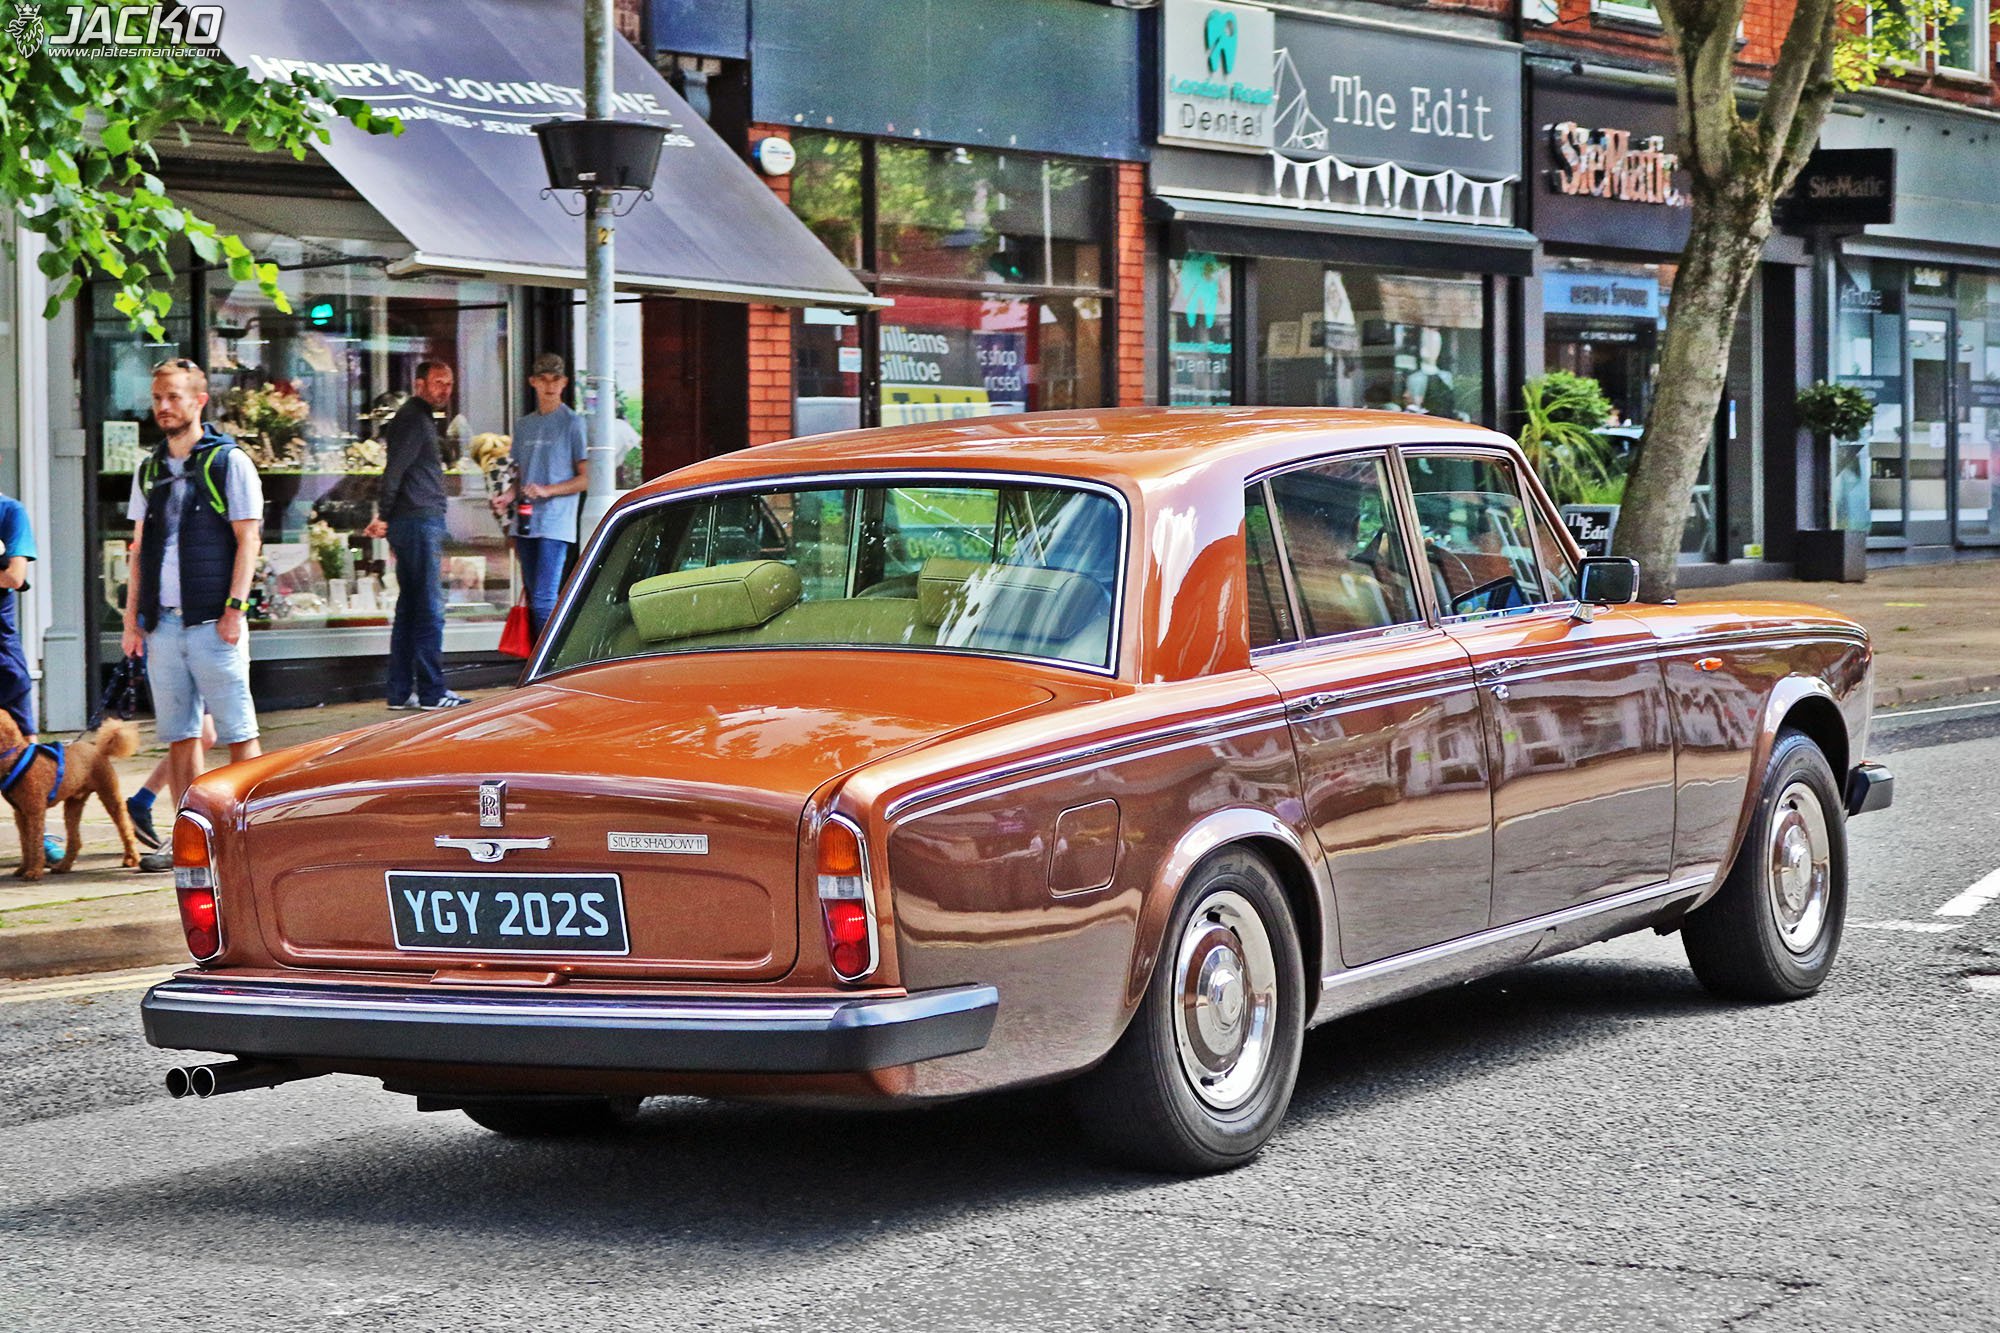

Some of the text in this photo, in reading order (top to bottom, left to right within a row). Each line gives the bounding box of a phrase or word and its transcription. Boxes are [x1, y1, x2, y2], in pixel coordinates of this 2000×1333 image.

[444, 77, 671, 116] JOHNSTNE
[1330, 75, 1494, 142] The Edit
[1182, 103, 1262, 136] Dental
[1176, 355, 1228, 374] Dental
[1565, 513, 1594, 528] The
[612, 836, 643, 849] SILVER
[643, 838, 694, 850] SHADOW
[403, 889, 609, 937] YGY 202S
